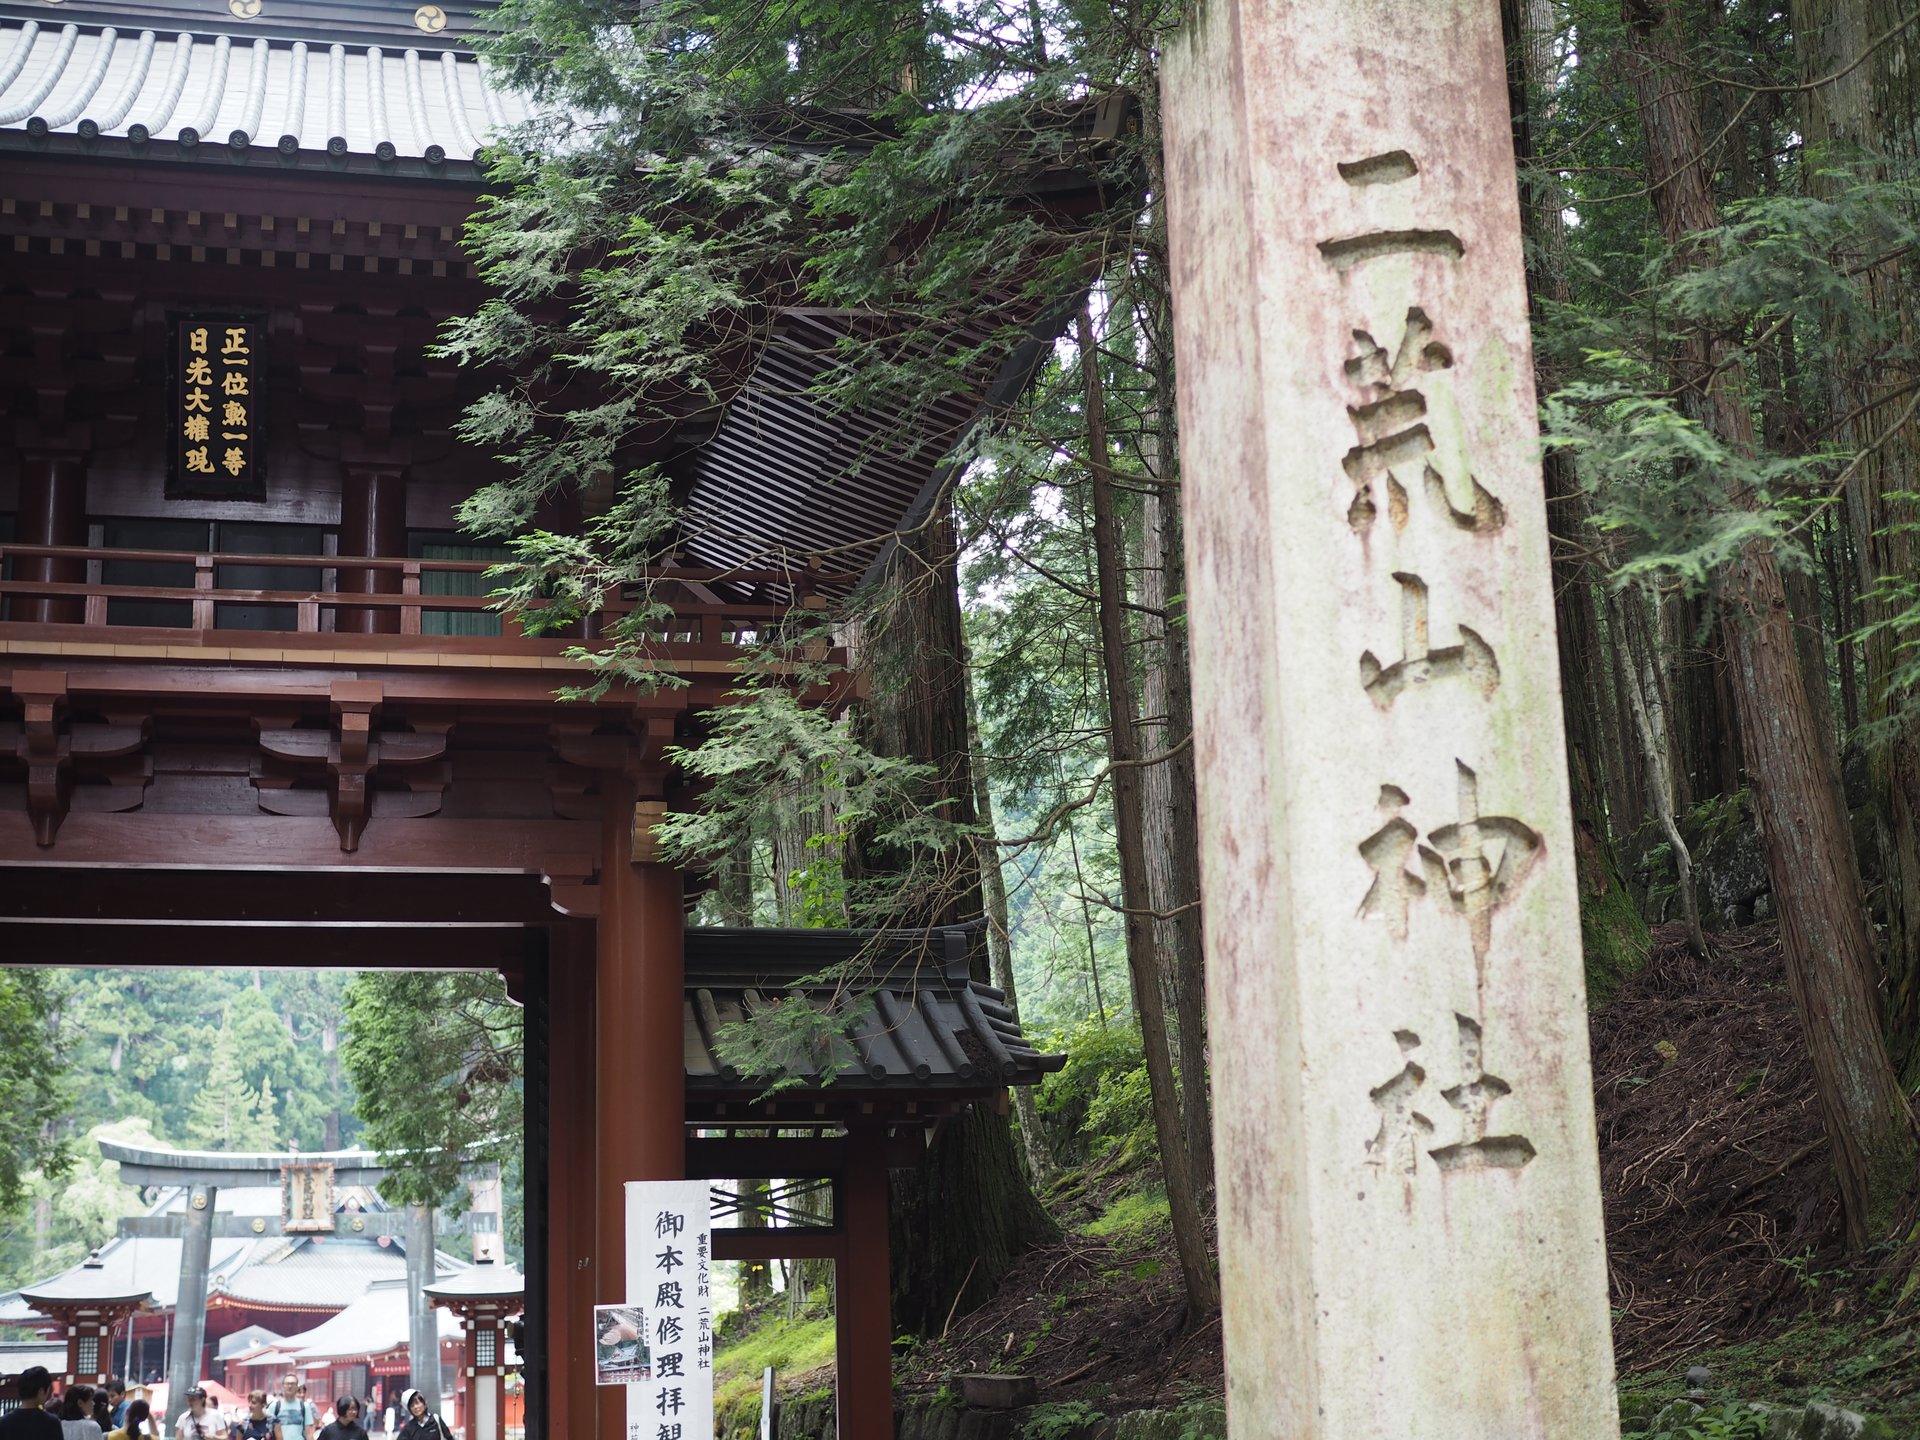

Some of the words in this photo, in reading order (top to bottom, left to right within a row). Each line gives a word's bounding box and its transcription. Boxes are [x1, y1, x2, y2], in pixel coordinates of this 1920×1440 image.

[1316, 149, 1545, 1176] 二荒山神社
[696, 1233, 709, 1297] 重要文化財
[697, 1306, 710, 1369] 二荒山神社
